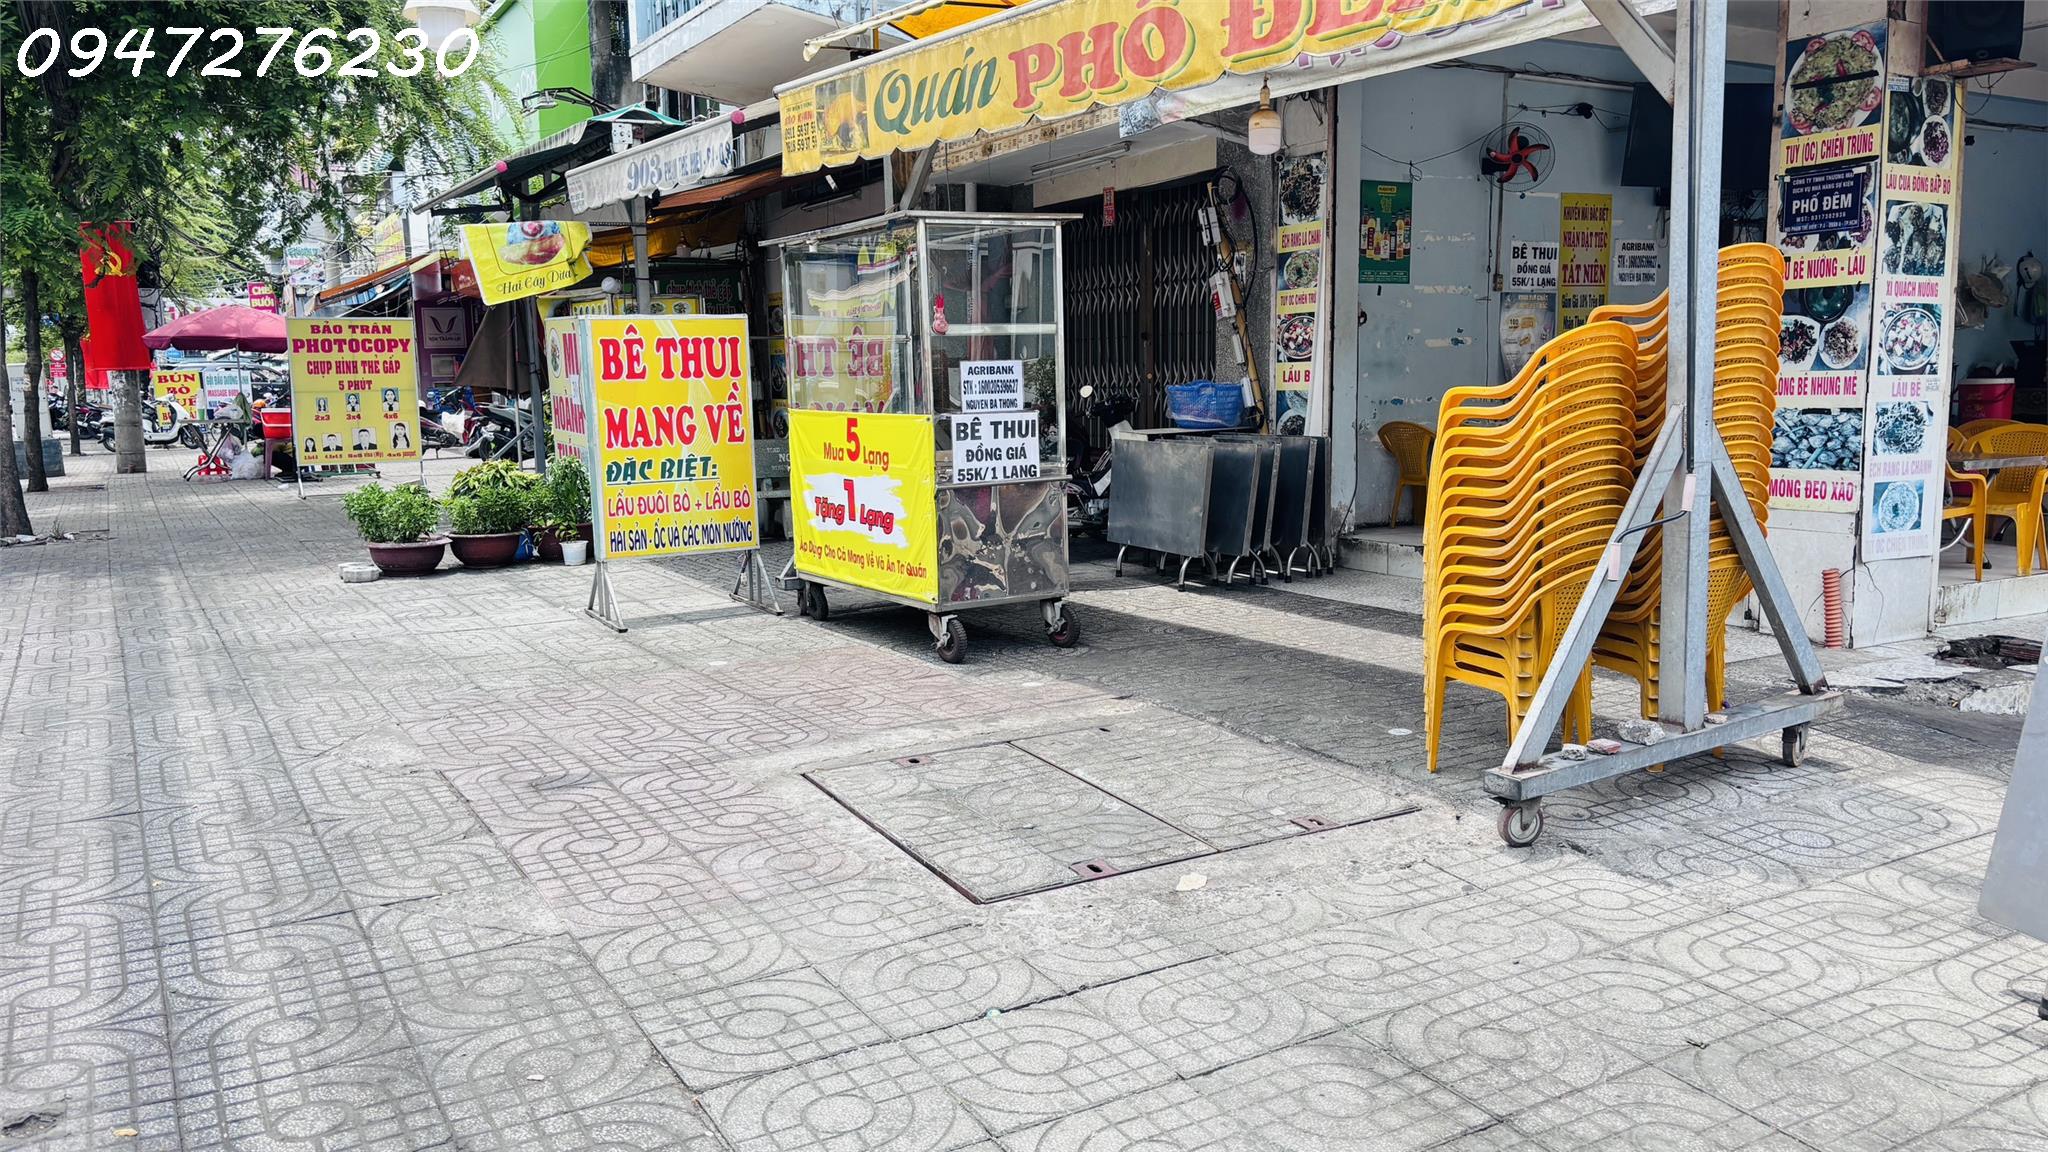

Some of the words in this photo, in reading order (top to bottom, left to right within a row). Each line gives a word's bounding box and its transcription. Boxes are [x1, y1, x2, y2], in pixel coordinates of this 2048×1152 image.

[872, 47, 1000, 135] Quán
[627, 153, 663, 192] 903
[1792, 191, 1820, 214] PHỐ
[1822, 191, 1853, 211] ĐÊM
[1512, 243, 1528, 260] BÊ
[1531, 246, 1558, 260] THUI
[1621, 242, 1655, 252] AGRIBANK
[1539, 262, 1551, 274] GIÁ
[1583, 258, 1606, 284] NIÊN
[1793, 256, 1804, 280] BÊ
[1848, 247, 1866, 276] LẨU
[348, 322, 392, 335] TRÂN
[292, 338, 411, 353] PHOTOCOPY
[600, 324, 647, 380] BÊ
[656, 336, 743, 380] THUI
[157, 372, 197, 384] BÚN
[307, 360, 333, 379] CHỤP
[335, 356, 358, 375] HÌNH
[967, 365, 1015, 376] AGRIBANK
[207, 389, 228, 397] MASSAGE
[338, 380, 345, 391] 5
[347, 377, 373, 391] PHÚT
[963, 380, 974, 395] STK
[1797, 372, 1809, 396] BÊ
[1811, 372, 1841, 396] NHÚNG
[604, 405, 698, 449] MANG
[703, 382, 746, 444] VỀ
[965, 399, 989, 410] NGUYEN
[989, 399, 998, 409] BA
[998, 398, 1018, 409] THONG
[955, 416, 982, 441] BÊ
[990, 419, 1037, 440] THUI
[824, 441, 844, 461] Mua
[846, 417, 861, 462] 5
[863, 445, 890, 472] Lạng
[966, 442, 1003, 463] ĐỒNG
[1006, 442, 1028, 461] GIÁ
[606, 457, 653, 485] ĐẶC
[660, 453, 718, 481] BIỆT:
[1769, 474, 1801, 498] MÓNG
[608, 488, 634, 518] LẨU
[637, 489, 669, 515] ĐUÔI
[673, 487, 691, 512] BÒ
[705, 482, 730, 511] LẨU
[733, 484, 751, 508] BÒ
[814, 495, 846, 526] Tặng
[843, 478, 857, 522] 1
[859, 503, 895, 535] Lạng
[610, 523, 627, 553] HẢI
[628, 521, 648, 551] SẢN
[653, 517, 666, 550] ỐC
[668, 520, 681, 547] VÀ
[682, 519, 700, 547] CÁC
[701, 517, 722, 544] MÓN
[723, 515, 753, 543] NƯỚNG
[824, 544, 836, 559] Cho
[836, 546, 847, 561] Cả
[847, 548, 865, 570] Mang
